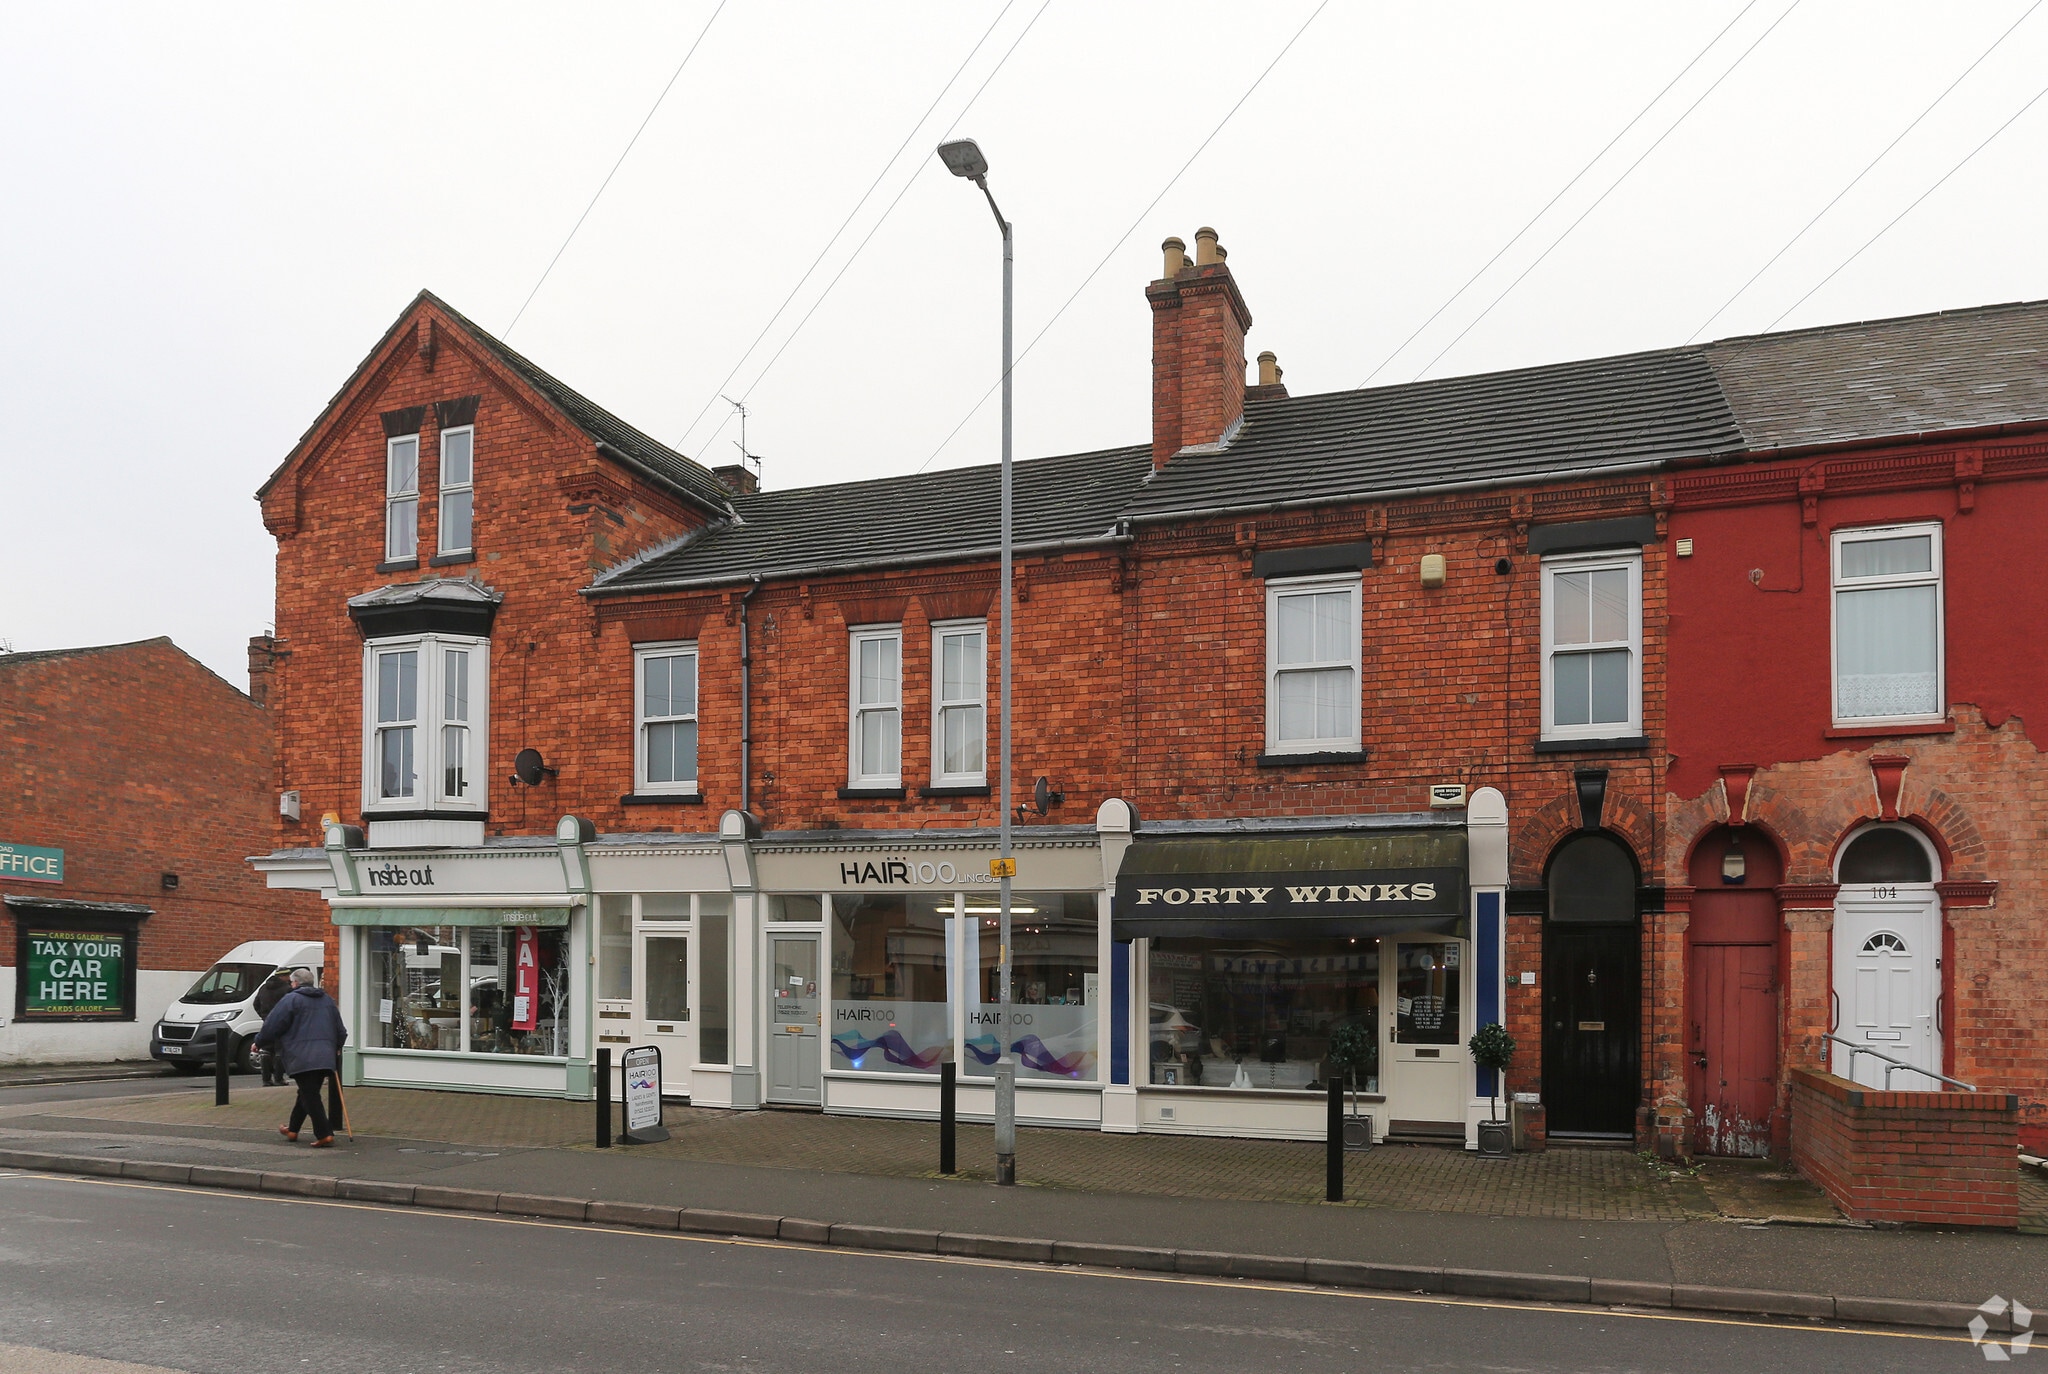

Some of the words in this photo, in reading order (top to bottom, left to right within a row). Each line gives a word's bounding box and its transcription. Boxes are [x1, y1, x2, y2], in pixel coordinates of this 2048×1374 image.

[0, 853, 58, 875] FFICE
[368, 863, 408, 886] inside
[410, 864, 435, 886] out
[1135, 886, 1275, 905] FORTY
[1284, 881, 1437, 904] WINKS
[1870, 886, 1897, 900] 104
[503, 911, 525, 922] inside
[48, 932, 75, 940] CARDS
[76, 933, 105, 941] GALORE
[32, 940, 68, 956] TAX
[72, 942, 122, 957] YOUR
[49, 958, 102, 978] CAR
[40, 981, 108, 1000] HERE
[46, 1005, 73, 1013] CARDS
[635, 1057, 650, 1066] OPEN
[629, 1068, 657, 1079] HAIR100
